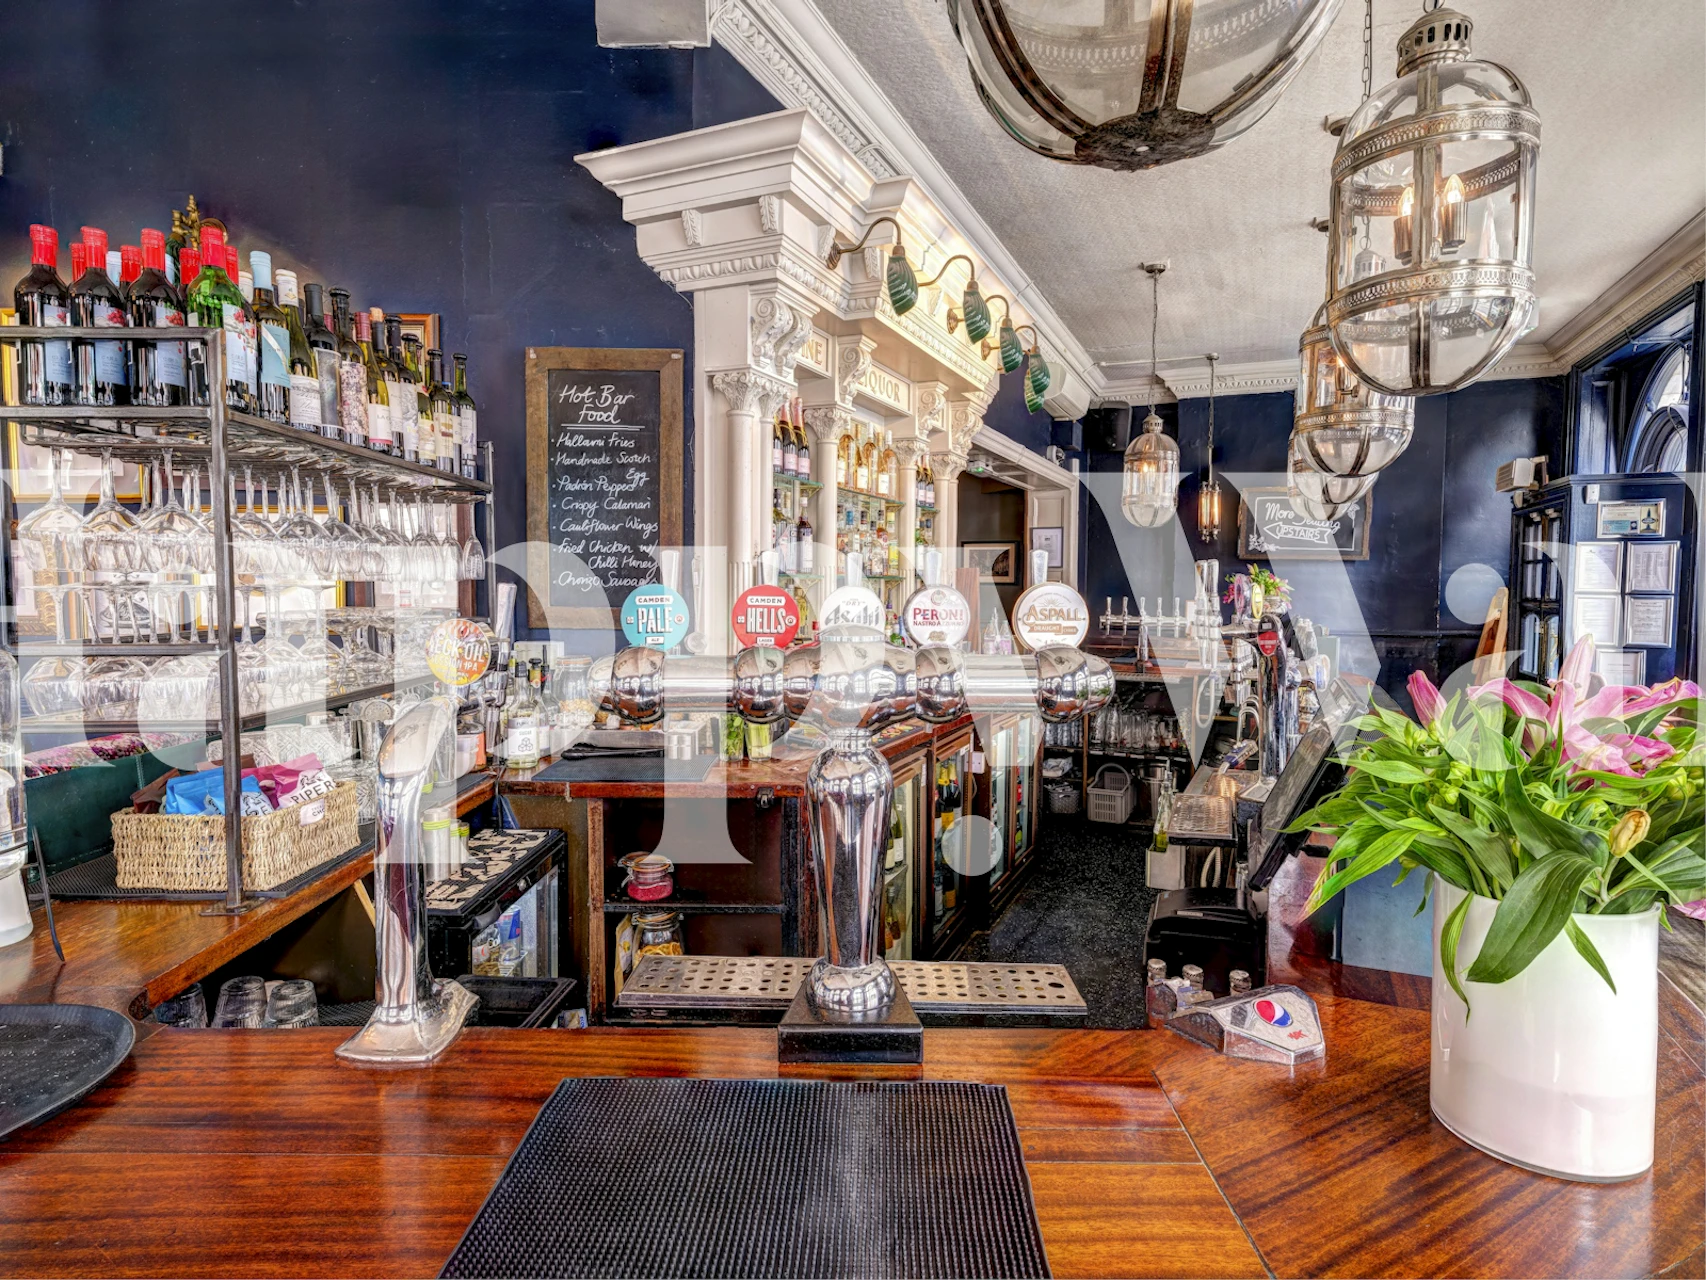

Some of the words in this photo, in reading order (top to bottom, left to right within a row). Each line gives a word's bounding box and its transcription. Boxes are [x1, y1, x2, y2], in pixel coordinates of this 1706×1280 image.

[801, 339, 822, 366] INE
[559, 385, 596, 404] Hot
[595, 385, 635, 407] Bar
[857, 370, 901, 403] IQUOR
[577, 404, 621, 424] Food
[608, 432, 636, 448] Fries
[555, 452, 613, 466] Handmade
[616, 451, 651, 464] Scotch
[626, 467, 650, 486] Egg
[561, 497, 599, 517] Crispy
[1265, 502, 1295, 521] More
[625, 515, 659, 539] Wings
[1276, 525, 1321, 540] UPSTAIRS
[558, 538, 586, 554] Fried
[589, 540, 633, 554] Chicken
[588, 555, 619, 570] Chilli
[637, 607, 673, 634] PALE
[746, 607, 787, 634] HELLS
[824, 604, 880, 626] Asahi
[913, 607, 964, 621] PERONI
[1024, 604, 1082, 621] ASPALL
[290, 778, 336, 804] PIPER
